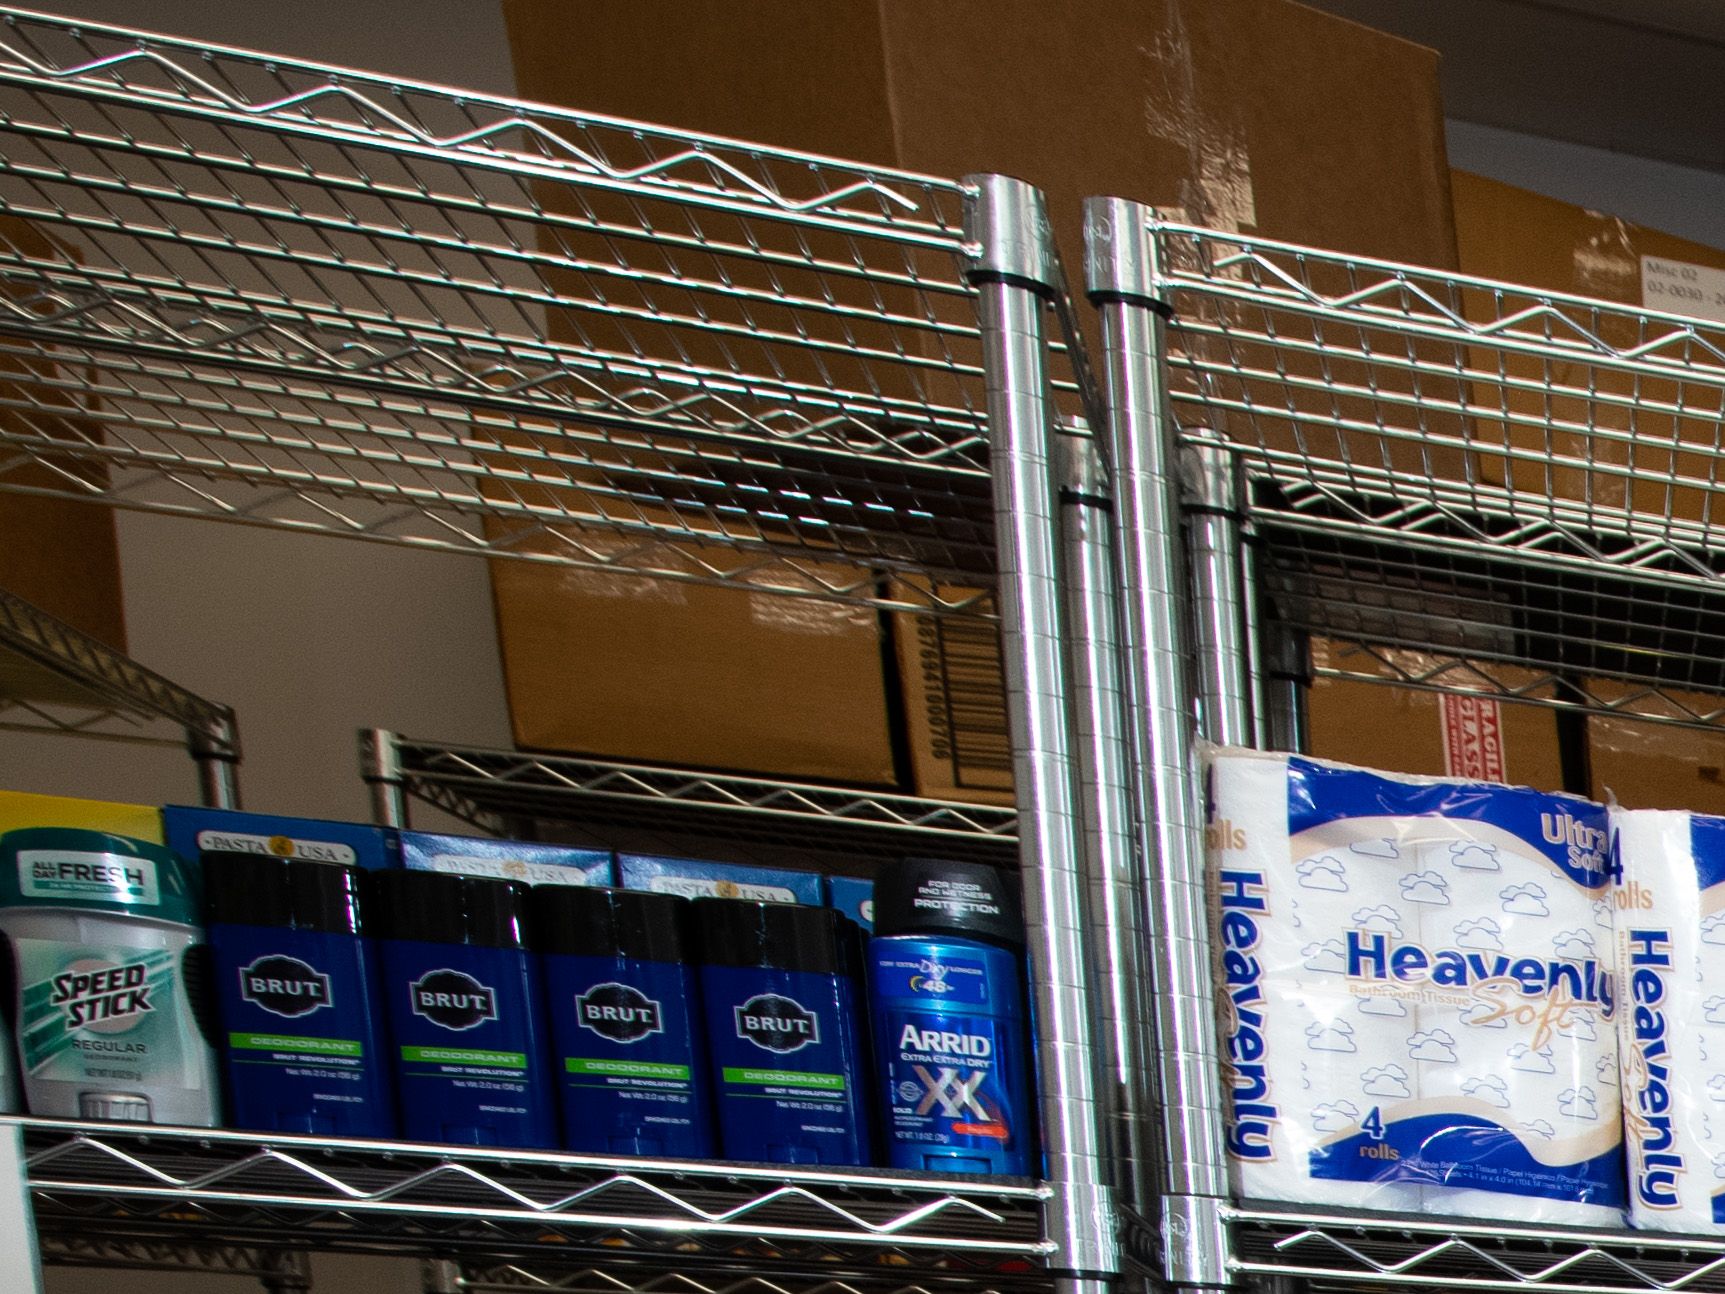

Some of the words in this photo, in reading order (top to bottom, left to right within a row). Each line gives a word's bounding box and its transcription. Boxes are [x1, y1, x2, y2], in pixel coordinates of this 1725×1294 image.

[1541, 812, 1608, 854] Ultra
[296, 844, 337, 862] USA
[59, 862, 144, 886] FRESH
[50, 964, 145, 1006] SPEED
[1346, 928, 1617, 1018] Heavenly
[251, 977, 323, 998] BRUT
[67, 987, 155, 1032] STICK
[420, 991, 487, 1011] BRUT
[585, 1003, 653, 1024] BRUT
[744, 1014, 814, 1034] BRUT
[1220, 867, 1278, 1162] Heavenly
[70, 1038, 147, 1055] REGULAR
[249, 1036, 356, 1054] DEODORANT
[899, 1023, 992, 1058] ARRID
[1627, 927, 1687, 1211] Heavenly
[1360, 1104, 1385, 1139] 4
[1358, 1142, 1400, 1161] rolls
